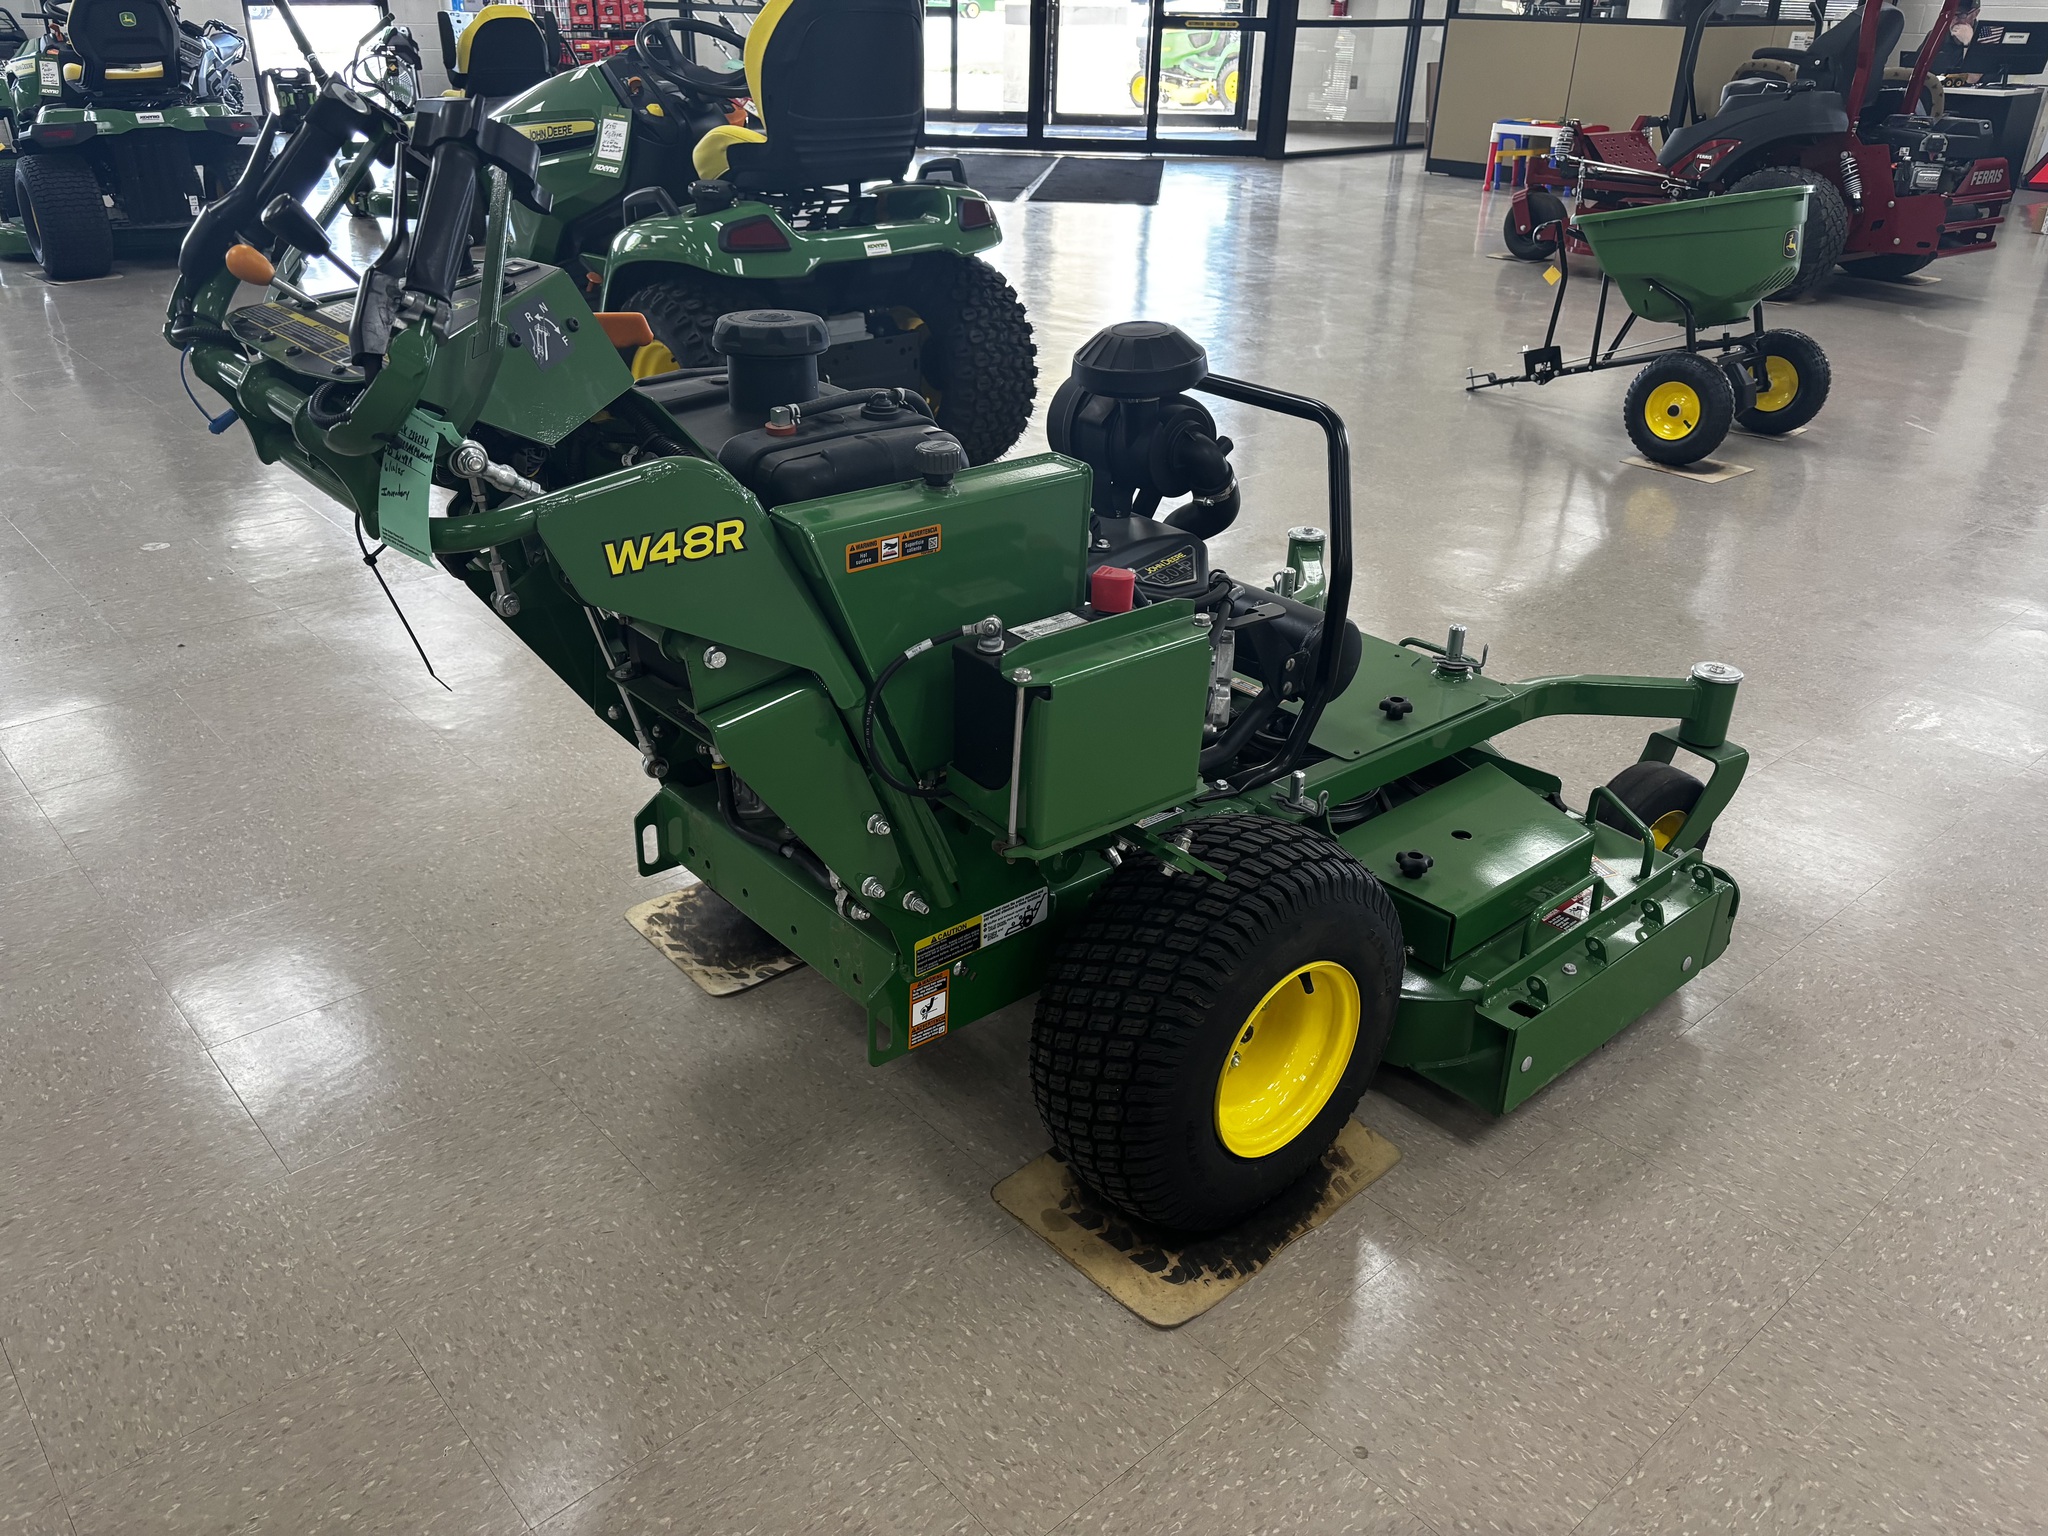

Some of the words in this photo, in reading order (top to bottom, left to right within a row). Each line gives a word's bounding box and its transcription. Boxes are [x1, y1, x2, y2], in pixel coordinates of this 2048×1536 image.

[529, 129, 546, 141] JOHN
[547, 124, 573, 138] DEERE
[1970, 169, 2004, 186] FERRIS
[538, 302, 549, 313] N
[524, 311, 534, 323] R
[561, 335, 569, 346] F
[381, 483, 410, 501] Inventory
[908, 526, 938, 538] ADVERTENCIA
[603, 518, 746, 577] W48R
[855, 541, 877, 551] WARNING
[904, 539, 924, 548] Superficie
[855, 557, 871, 565] surface
[1145, 562, 1165, 575] JOHN
[1161, 552, 1187, 565] DEERE
[1152, 569, 1179, 584] 19.0
[1174, 560, 1192, 574] HP
[937, 923, 967, 940] CAUTION
